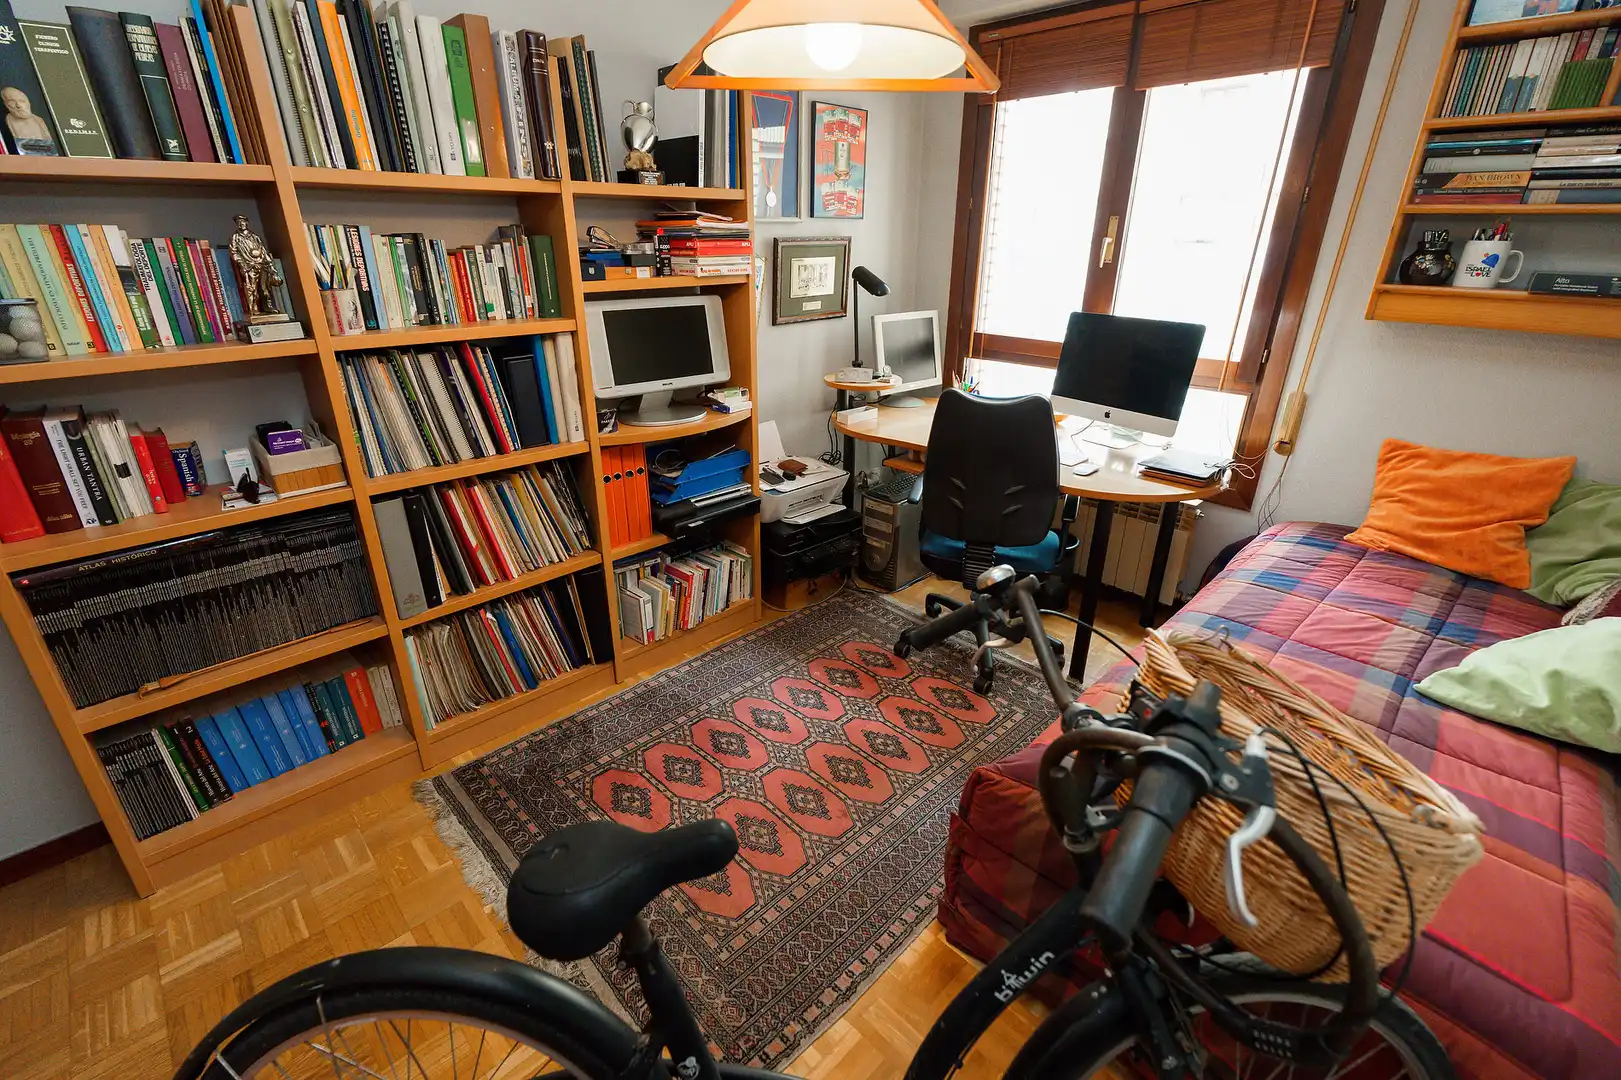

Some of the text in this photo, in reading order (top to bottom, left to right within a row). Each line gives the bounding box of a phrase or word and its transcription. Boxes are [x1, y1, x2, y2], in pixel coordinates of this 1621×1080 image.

[1466, 173, 1521, 182] DAN BROWN
[136, 242, 150, 270] DEPORTE
[350, 228, 363, 257] LESIONES
[131, 242, 152, 291] TRAUMATOLOGIA
[356, 256, 370, 292] DEPORTIVAS
[66, 263, 95, 322] LESIONES DEPORTIVAS
[56, 440, 65, 450] THE
[61, 450, 70, 462] LIGHT
[66, 463, 76, 478] SHALL
[80, 496, 88, 509] FREE
[76, 447, 102, 501] URBAN TANTRA
[178, 453, 195, 482] Spanish
[78, 560, 107, 572] ATLAS
[186, 726, 194, 734] 2
